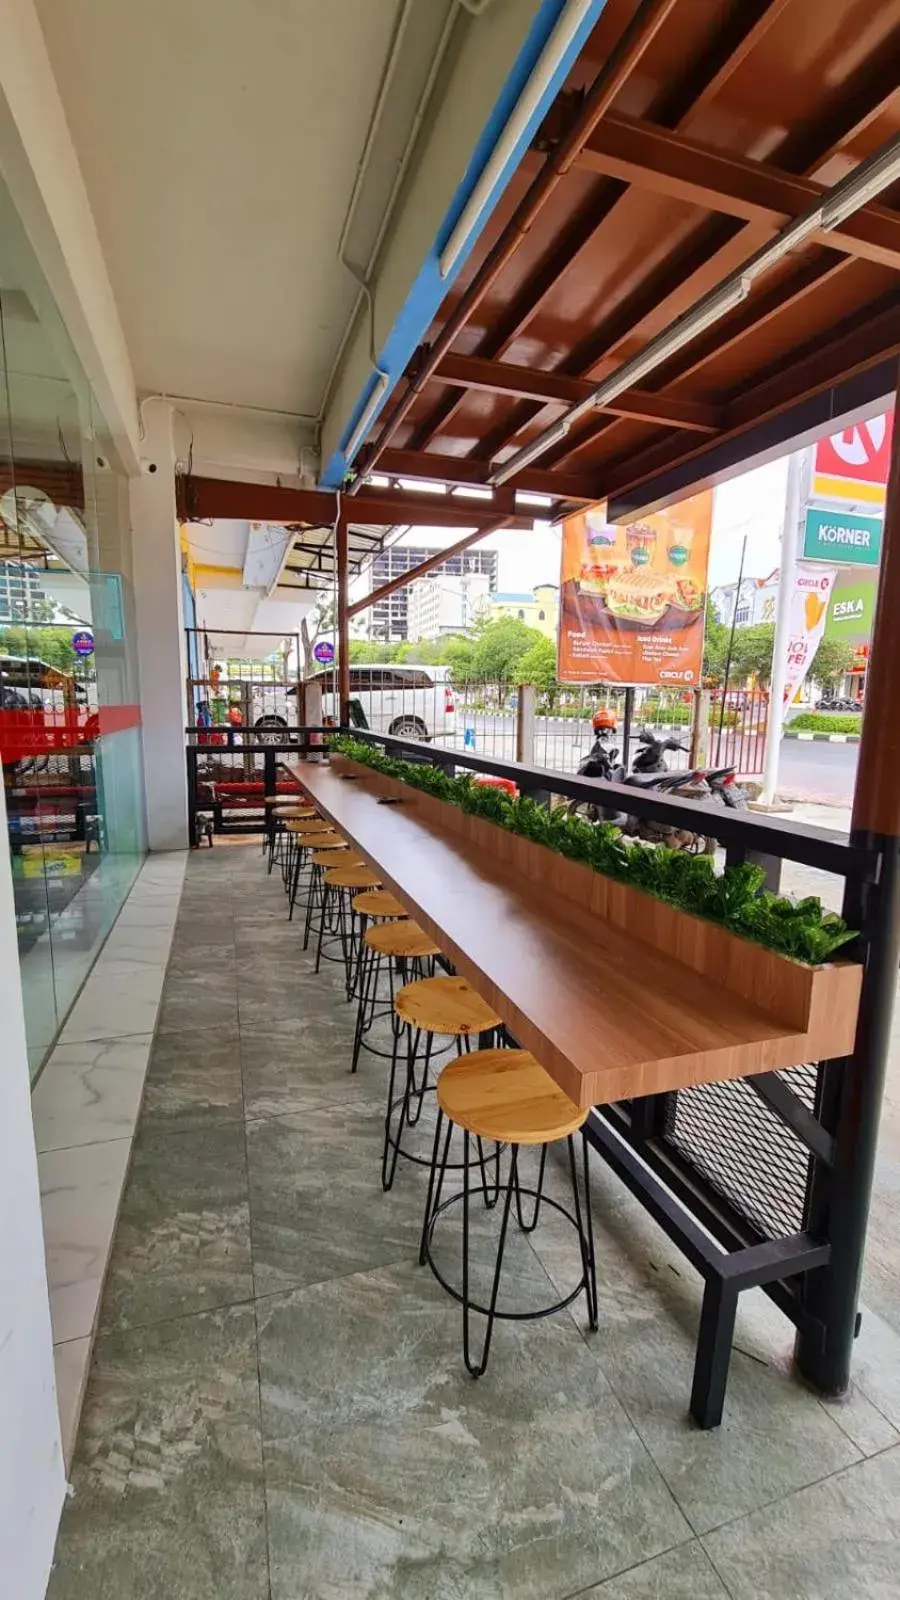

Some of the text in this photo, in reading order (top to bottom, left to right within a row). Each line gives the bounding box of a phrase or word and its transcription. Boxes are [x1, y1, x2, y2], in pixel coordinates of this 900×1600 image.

[818, 523, 871, 547] KÖRNER
[797, 577, 830, 590] CIRCLE K
[833, 598, 864, 615] ESKA
[567, 630, 586, 639] Food
[660, 671, 684, 679] CIRCLE
